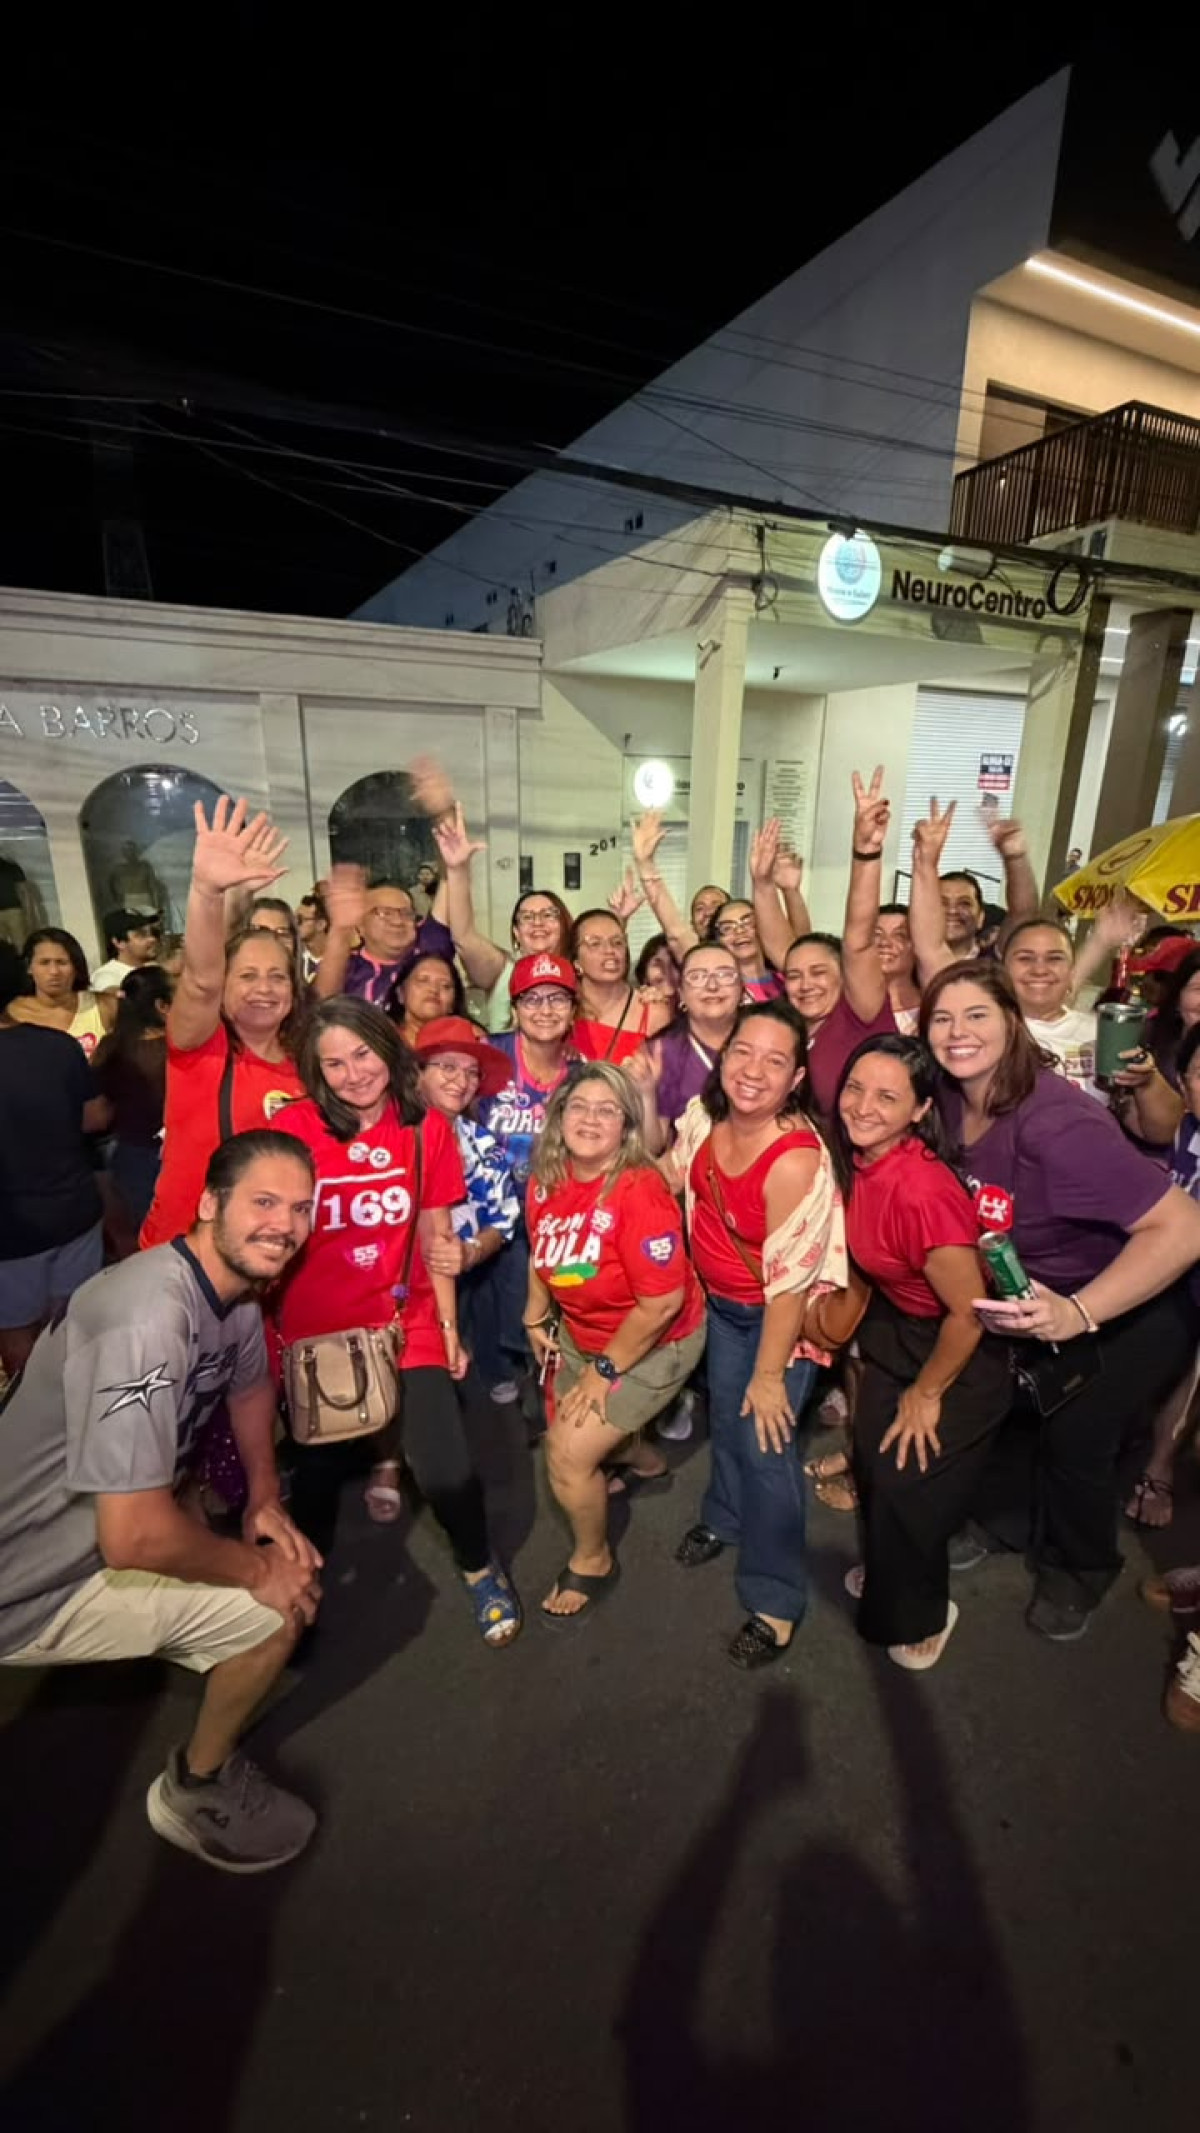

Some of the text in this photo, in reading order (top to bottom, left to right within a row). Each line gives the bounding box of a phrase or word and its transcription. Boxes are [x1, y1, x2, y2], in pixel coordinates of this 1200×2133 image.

[891, 569, 1046, 619] NeuroCentro
[40, 704, 199, 744] BARROS
[589, 836, 616, 856] 201
[321, 1186, 412, 1231] 169
[353, 1244, 378, 1262] 55
[535, 1232, 600, 1268] LULA
[649, 1237, 672, 1256] 55
